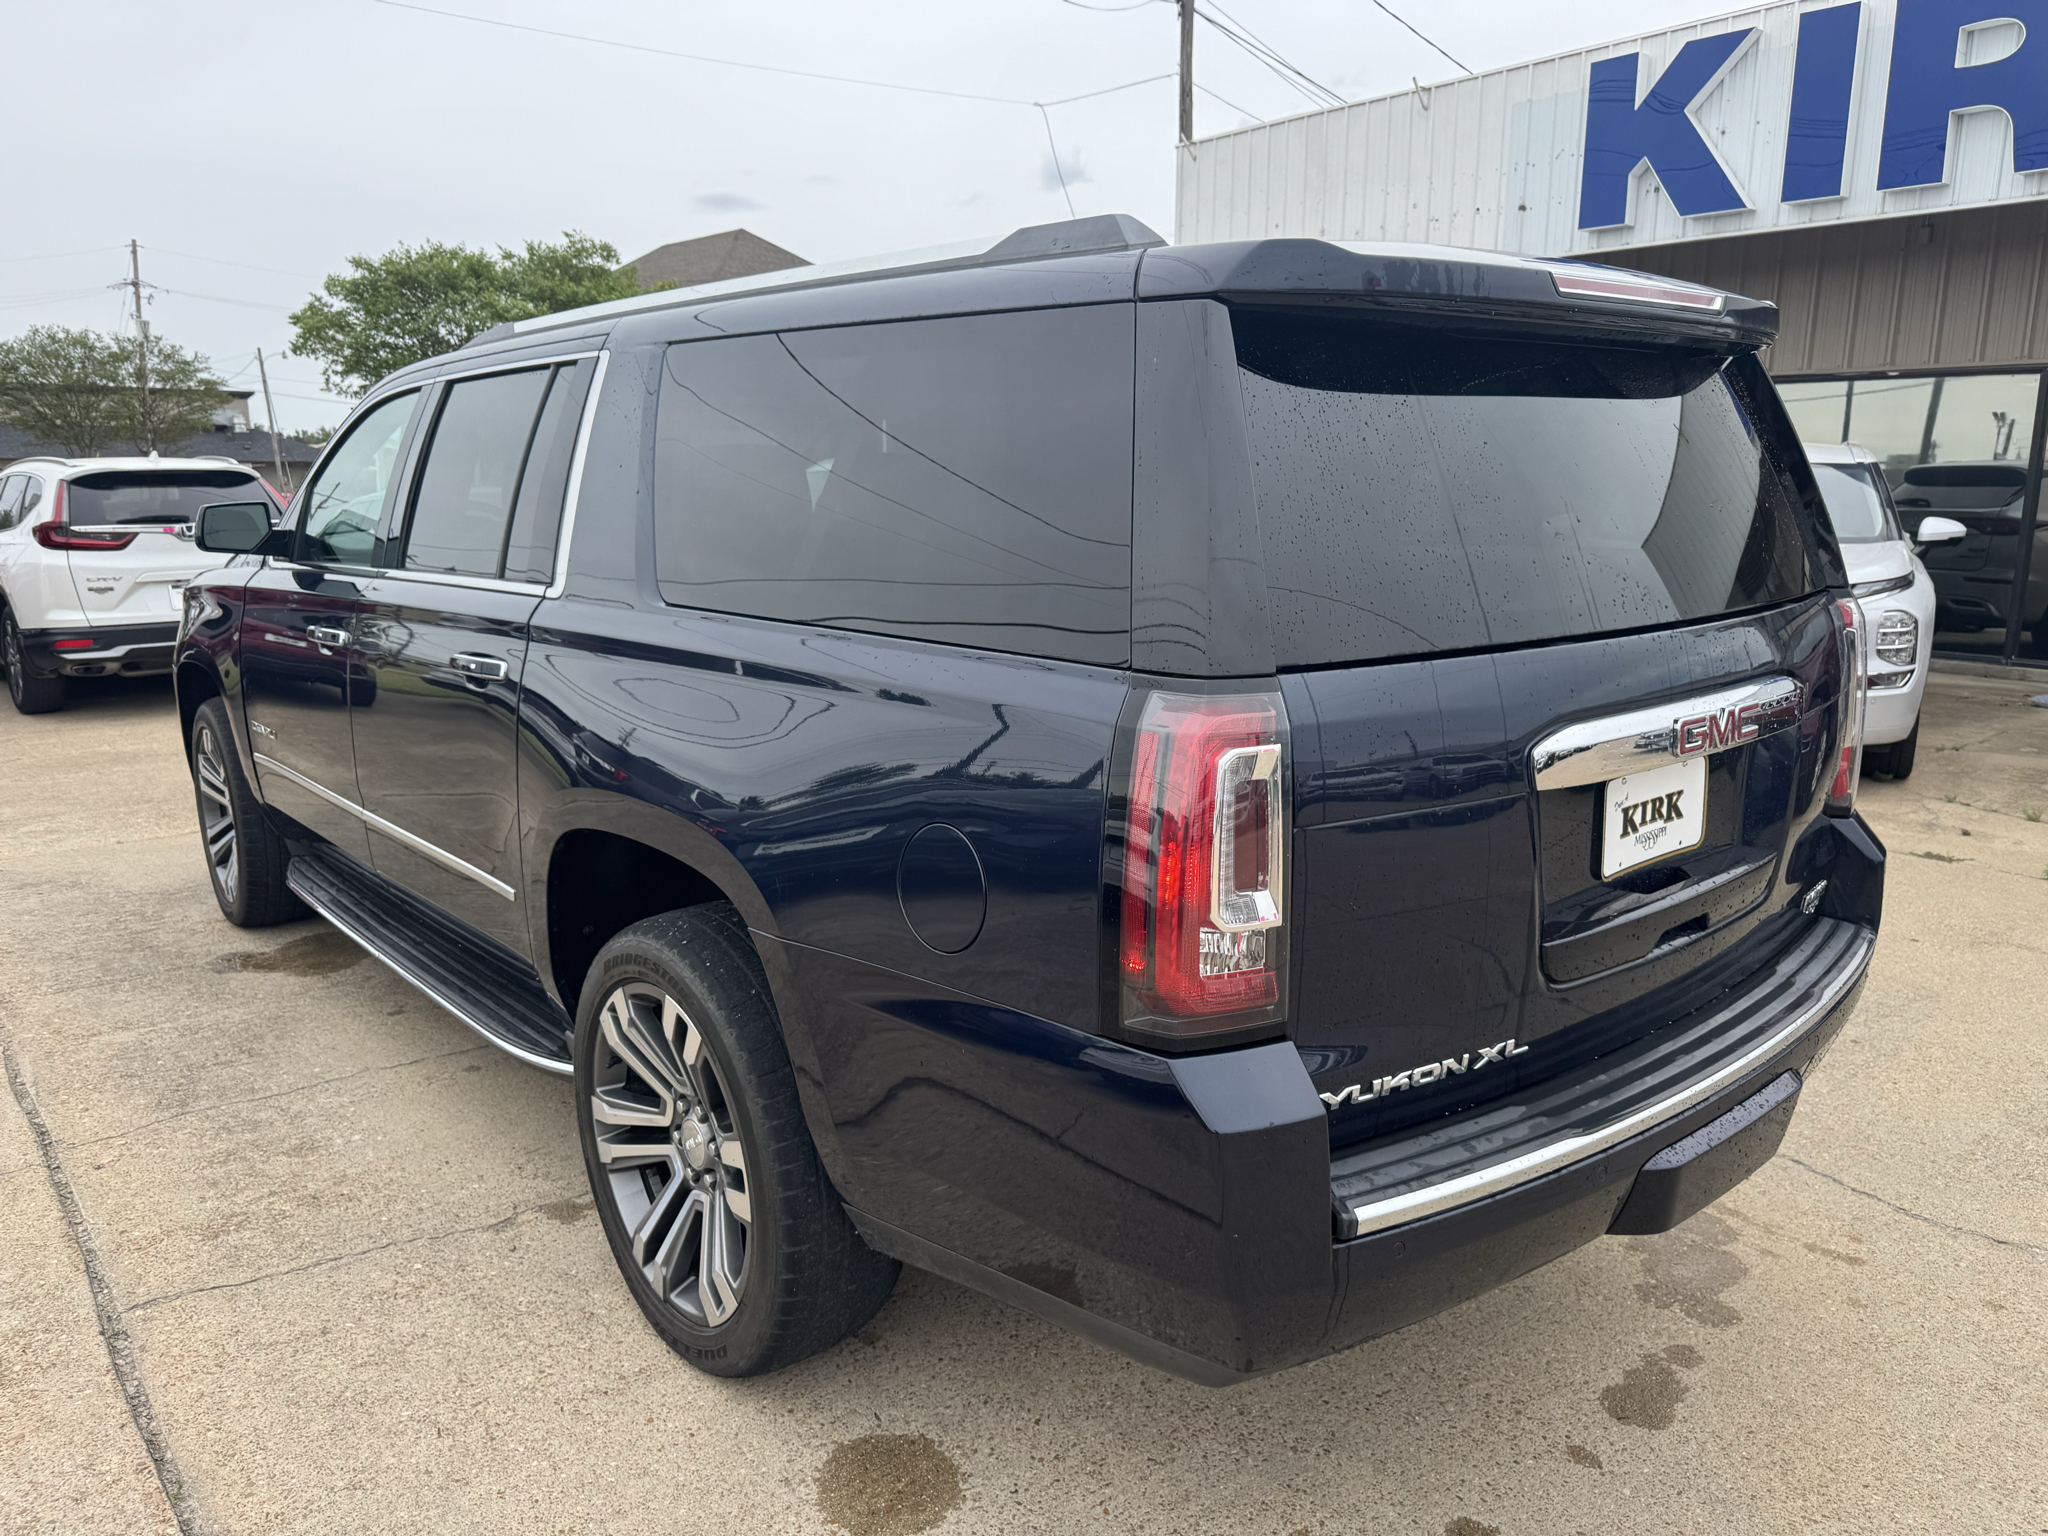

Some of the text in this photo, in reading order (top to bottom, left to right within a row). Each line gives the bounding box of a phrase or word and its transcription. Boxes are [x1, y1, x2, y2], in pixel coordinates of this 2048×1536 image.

[1678, 699, 1759, 757] GMC
[1620, 789, 1684, 839] KIRK
[1319, 1038, 1529, 1110] YUKON XL
